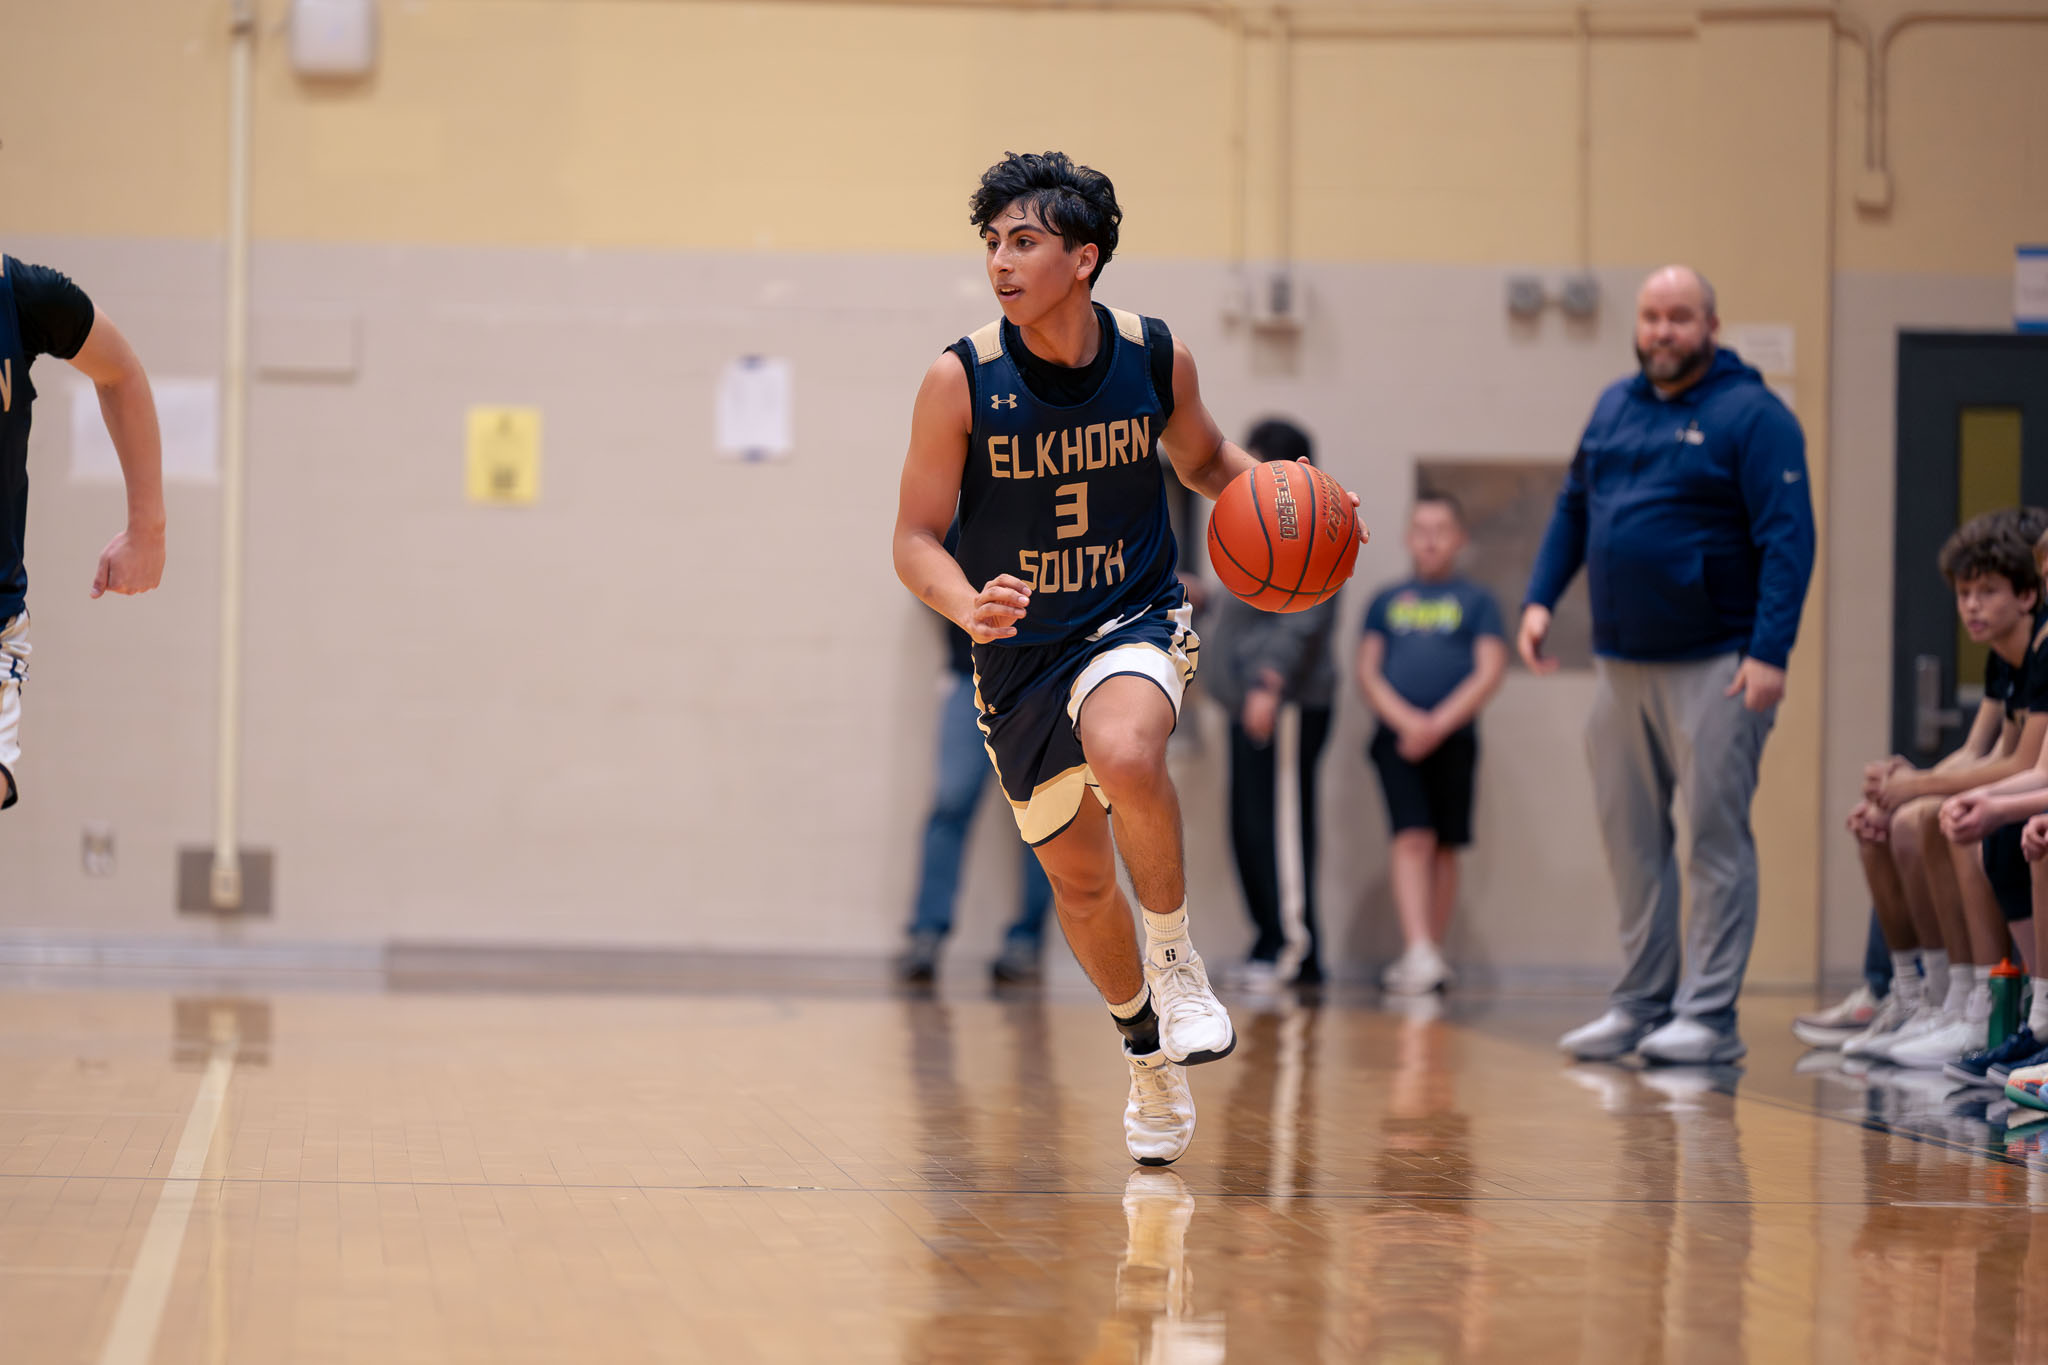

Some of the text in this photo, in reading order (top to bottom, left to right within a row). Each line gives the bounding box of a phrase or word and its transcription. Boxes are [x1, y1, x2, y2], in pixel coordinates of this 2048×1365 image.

[988, 416, 1150, 479] ELKHORN
[1055, 481, 1089, 540] 3
[1279, 503, 1298, 538] PRO
[1019, 539, 1126, 594] SOUTH
